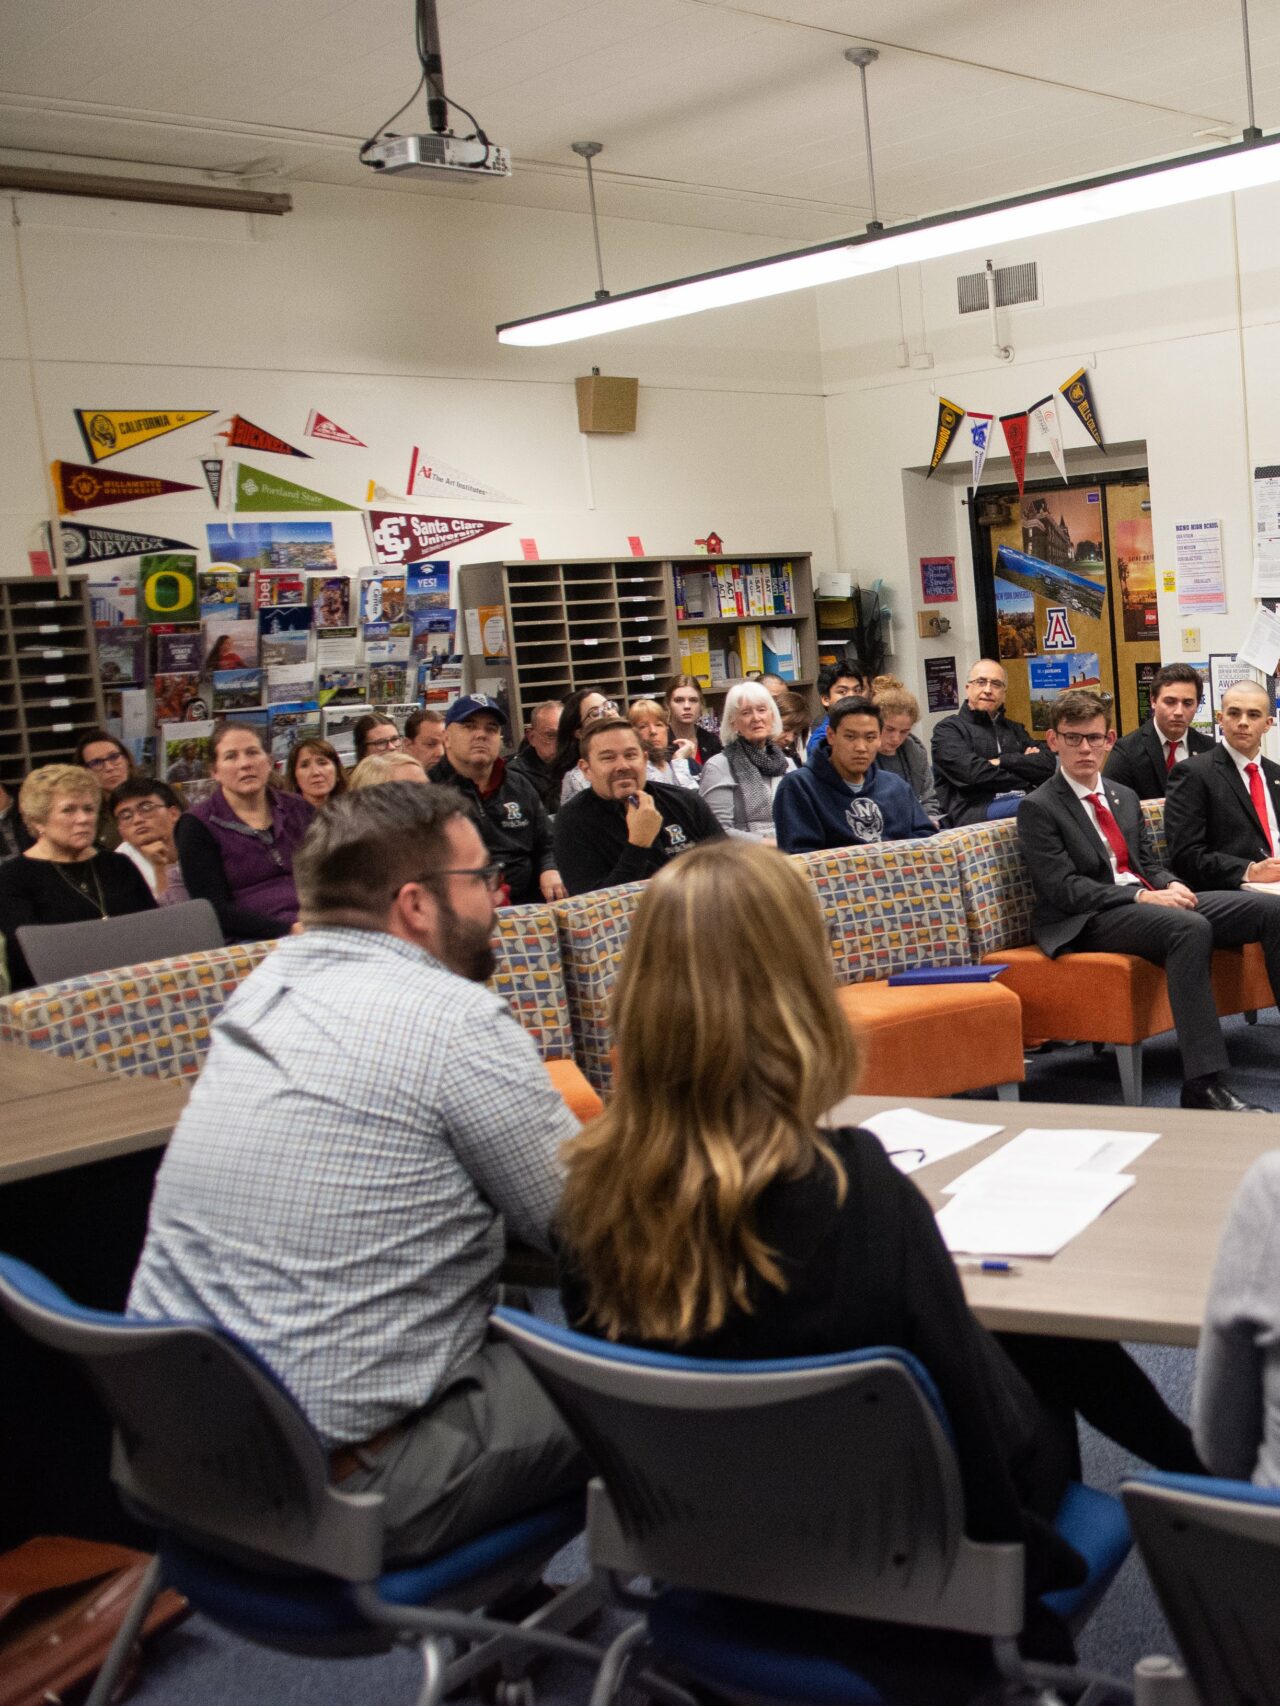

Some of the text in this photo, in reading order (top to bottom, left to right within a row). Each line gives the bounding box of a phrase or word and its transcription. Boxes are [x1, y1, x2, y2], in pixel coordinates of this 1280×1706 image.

[118, 415, 170, 435] CALIFORNIA
[931, 425, 951, 467] DOMINICAN
[433, 473, 444, 482] The
[445, 478, 455, 486] Art
[261, 484, 300, 499] Portland
[88, 529, 148, 542] UNIVERSITY
[410, 517, 485, 536] Santa Clara
[418, 528, 482, 548] University
[88, 540, 169, 559] NEVADA
[417, 578, 437, 588] YES!
[726, 581, 735, 601] ACT
[372, 588, 382, 615] Center
[1042, 606, 1077, 651] A
[503, 801, 522, 820] R
[665, 824, 687, 845] R
